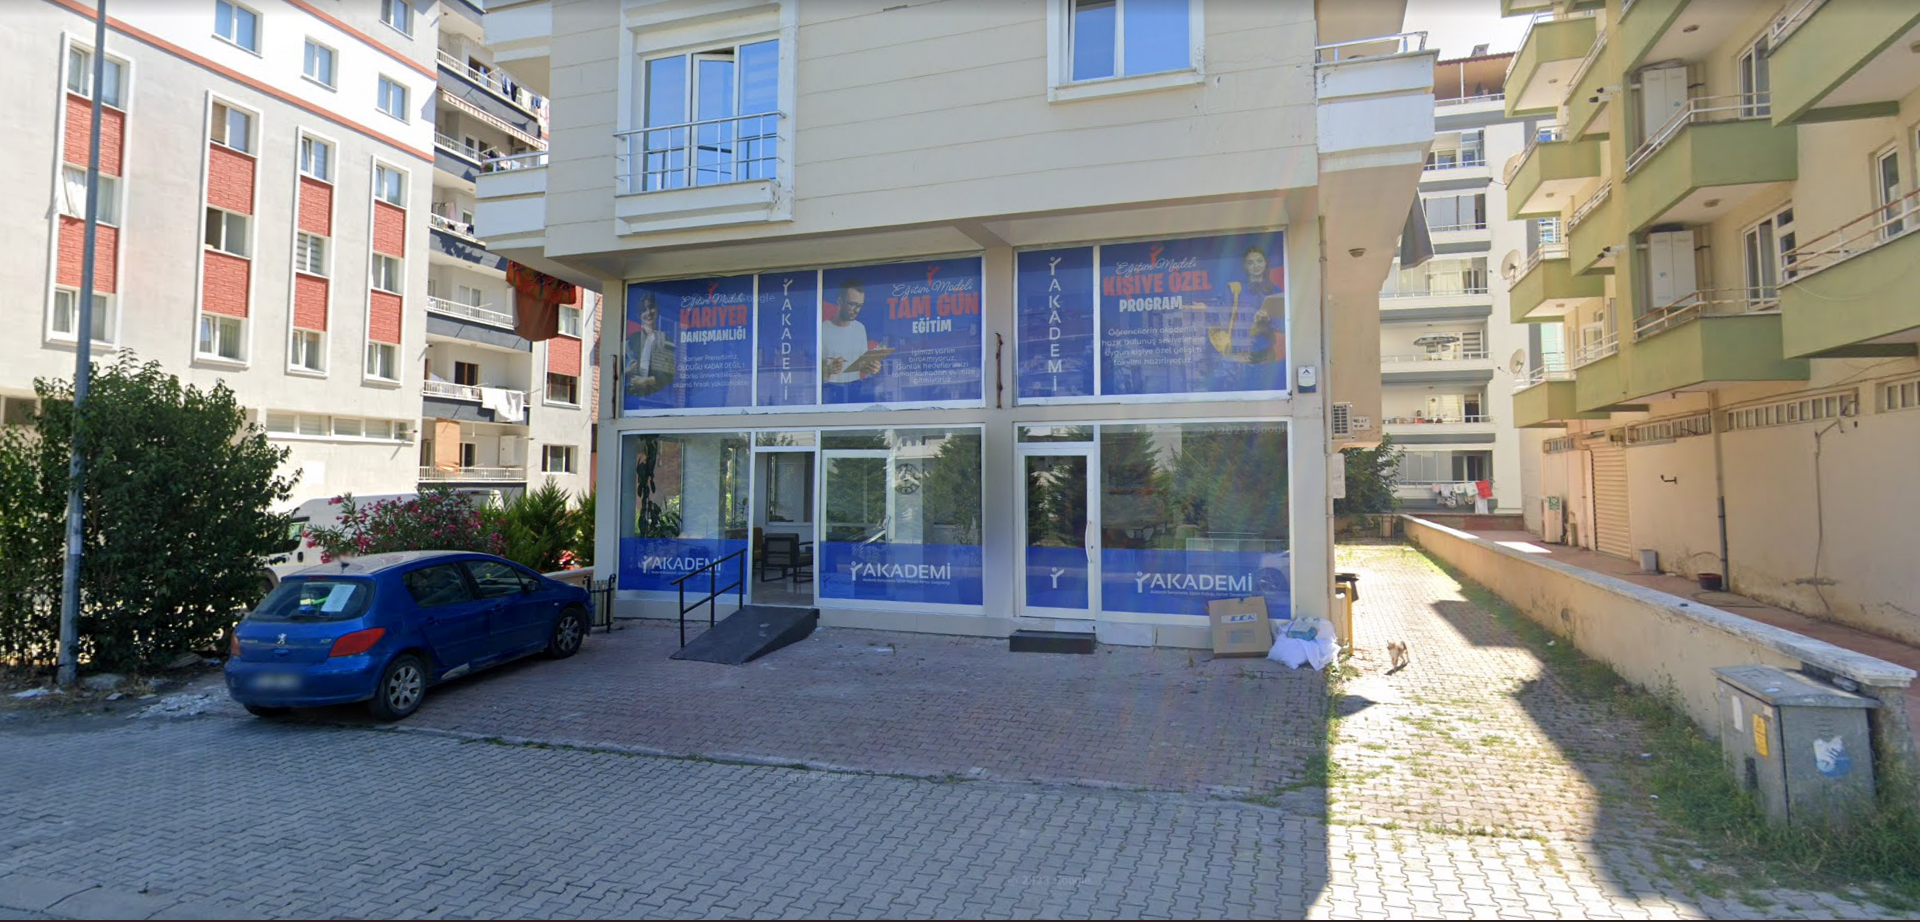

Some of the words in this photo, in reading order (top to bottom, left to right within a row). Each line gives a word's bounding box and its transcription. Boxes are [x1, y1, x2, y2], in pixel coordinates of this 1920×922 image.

[891, 283, 931, 300] Eğitim
[932, 278, 974, 294] Modeli
[1103, 272, 1164, 299] KİŞİYE
[1168, 268, 1212, 292] ÖZEL
[887, 296, 931, 319] TAM
[937, 289, 979, 316] GÜN
[1118, 295, 1183, 313] PROGRAM
[679, 304, 747, 328] KARİYER
[912, 317, 952, 333] EĞİTİM
[680, 326, 746, 345] DANIŞMANLIĞI
